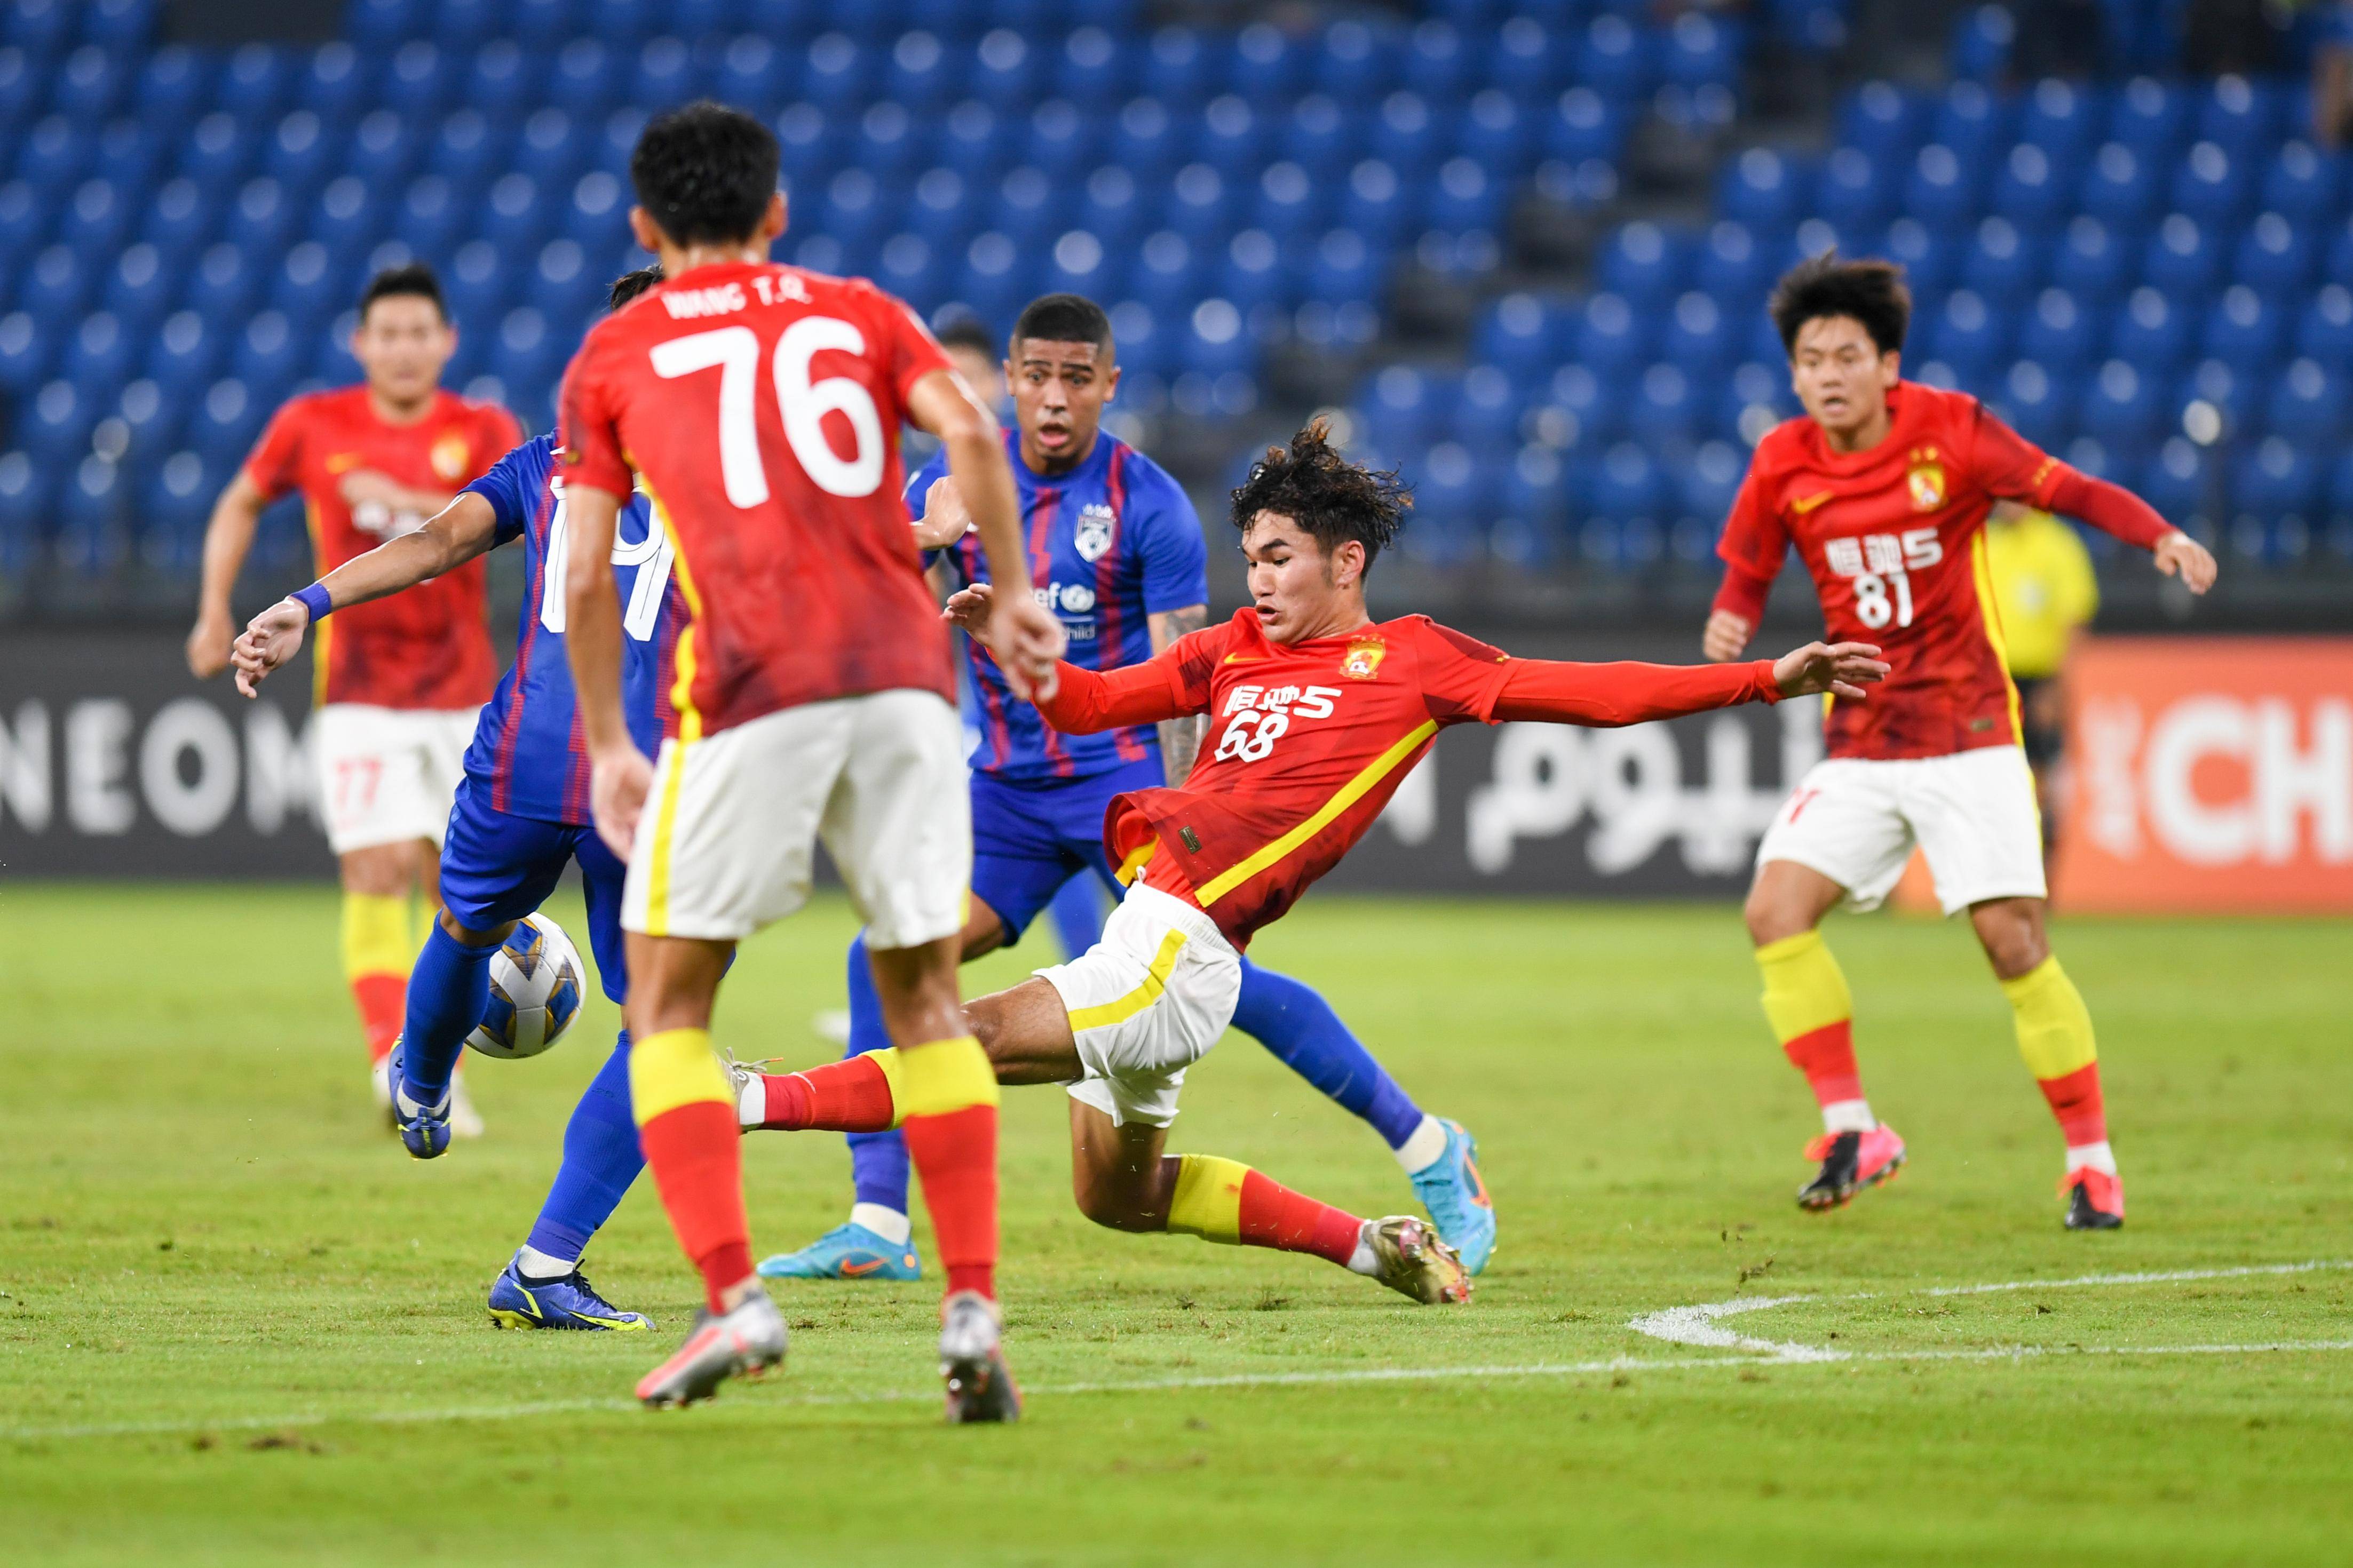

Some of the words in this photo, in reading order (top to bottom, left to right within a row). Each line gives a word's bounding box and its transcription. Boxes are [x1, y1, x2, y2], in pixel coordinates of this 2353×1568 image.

[661, 282, 747, 320] WANG
[649, 315, 885, 509] 76
[1853, 572, 1914, 630] 81
[1214, 709, 1289, 763] 68
[332, 752, 386, 811] 77
